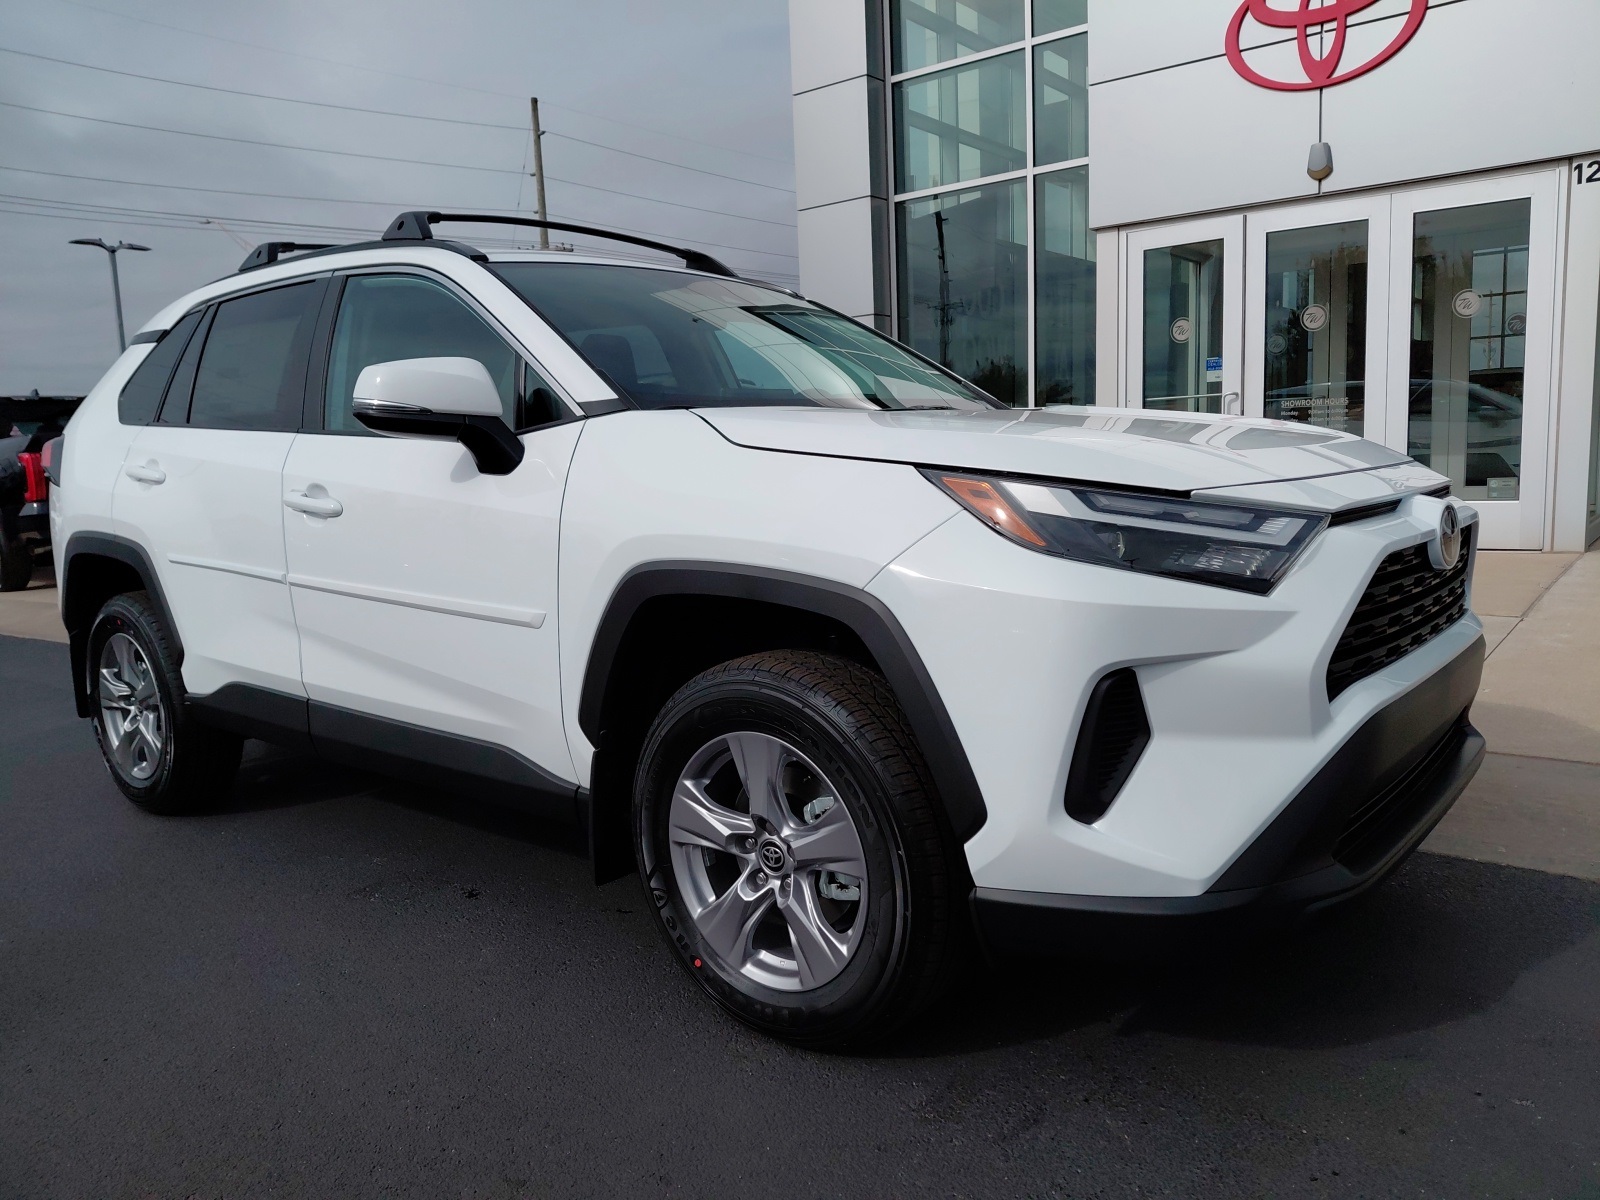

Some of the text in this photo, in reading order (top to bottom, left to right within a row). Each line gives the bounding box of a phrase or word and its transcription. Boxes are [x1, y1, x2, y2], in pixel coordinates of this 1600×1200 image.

[1573, 160, 1600, 185] 12
[1281, 397, 1349, 407] SHOWROOM HOURS
